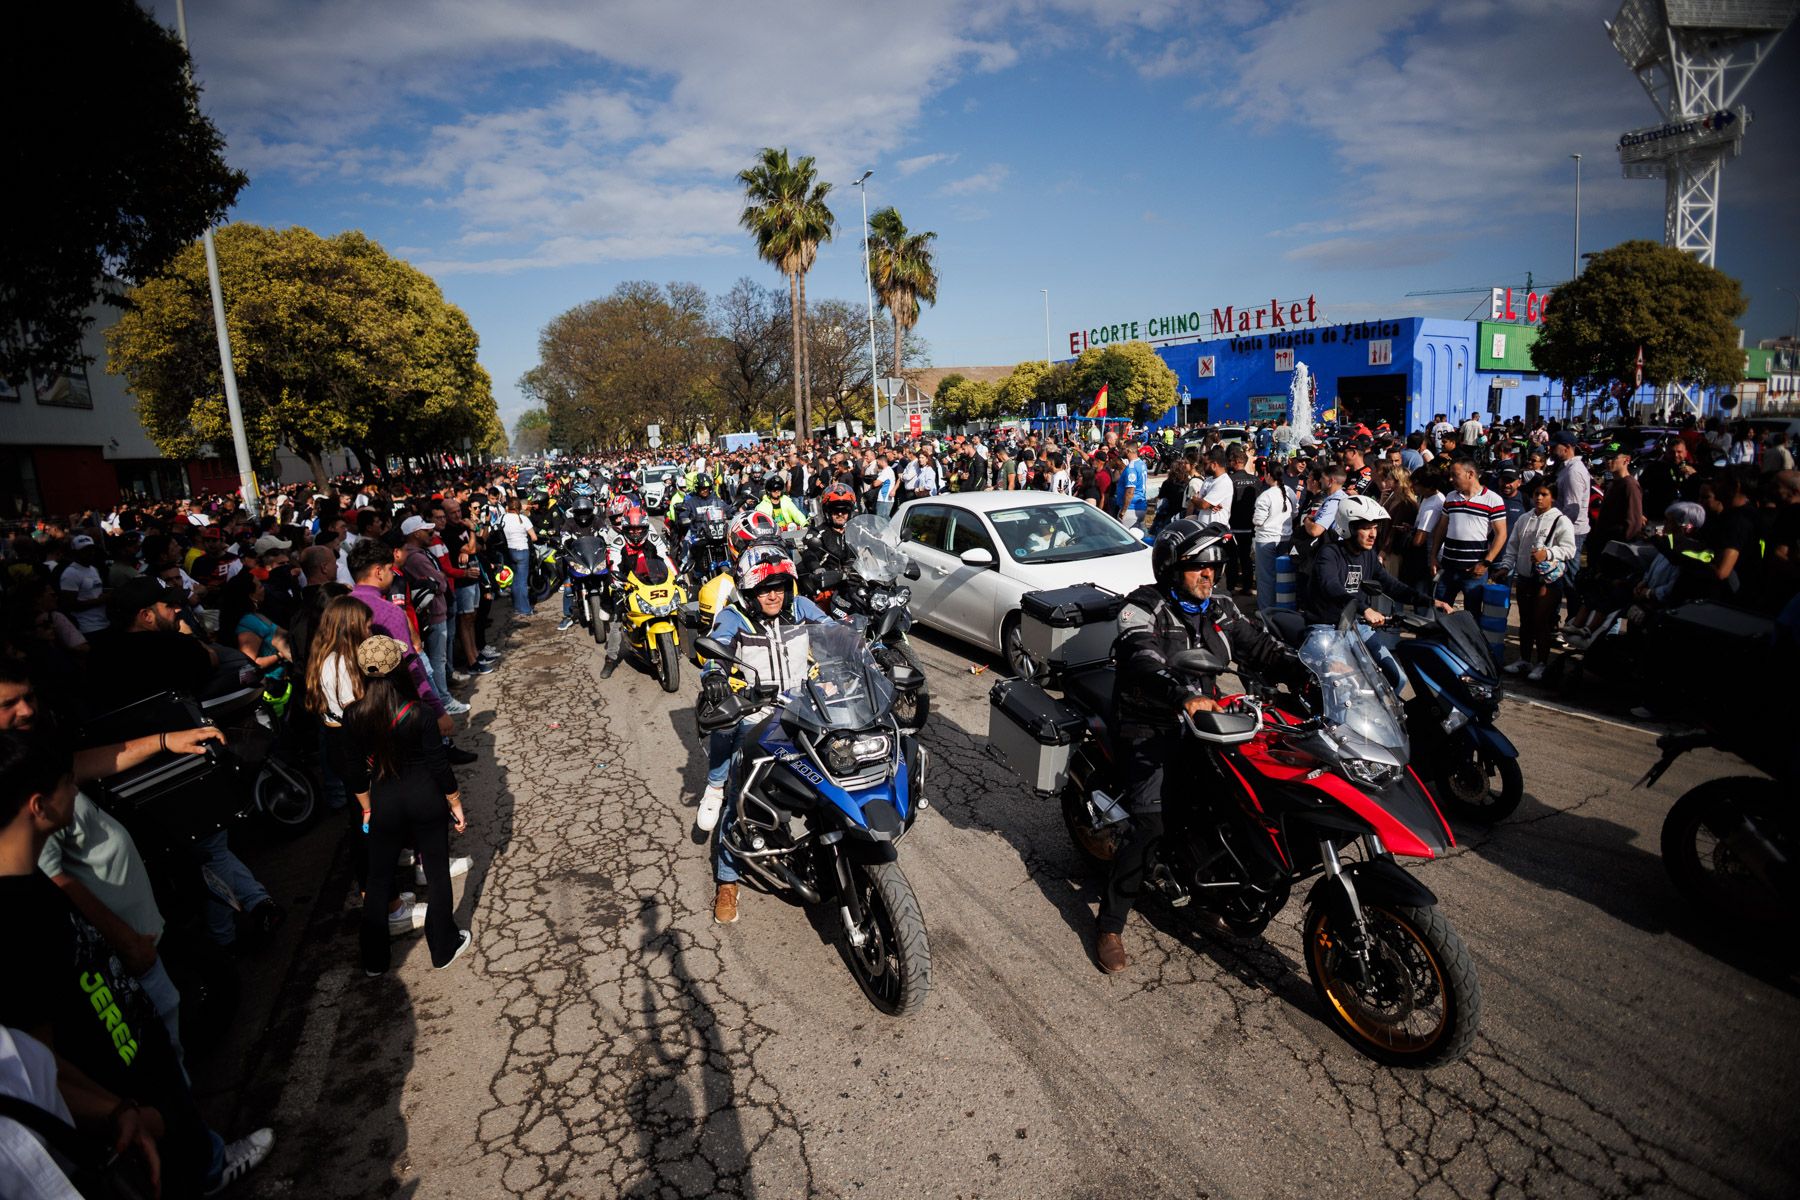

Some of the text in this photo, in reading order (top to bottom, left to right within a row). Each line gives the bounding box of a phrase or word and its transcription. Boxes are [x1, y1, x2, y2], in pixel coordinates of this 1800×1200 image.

[1621, 121, 1697, 147] Carrefour
[1091, 321, 1139, 345] CORTE
[1149, 311, 1200, 336] CHINO
[1212, 293, 1317, 335] Market
[1492, 287, 1516, 320] EL
[1322, 326, 1337, 343] de
[650, 589, 669, 601] 53
[774, 746, 824, 785] R200
[80, 971, 138, 1066] JEREZ
